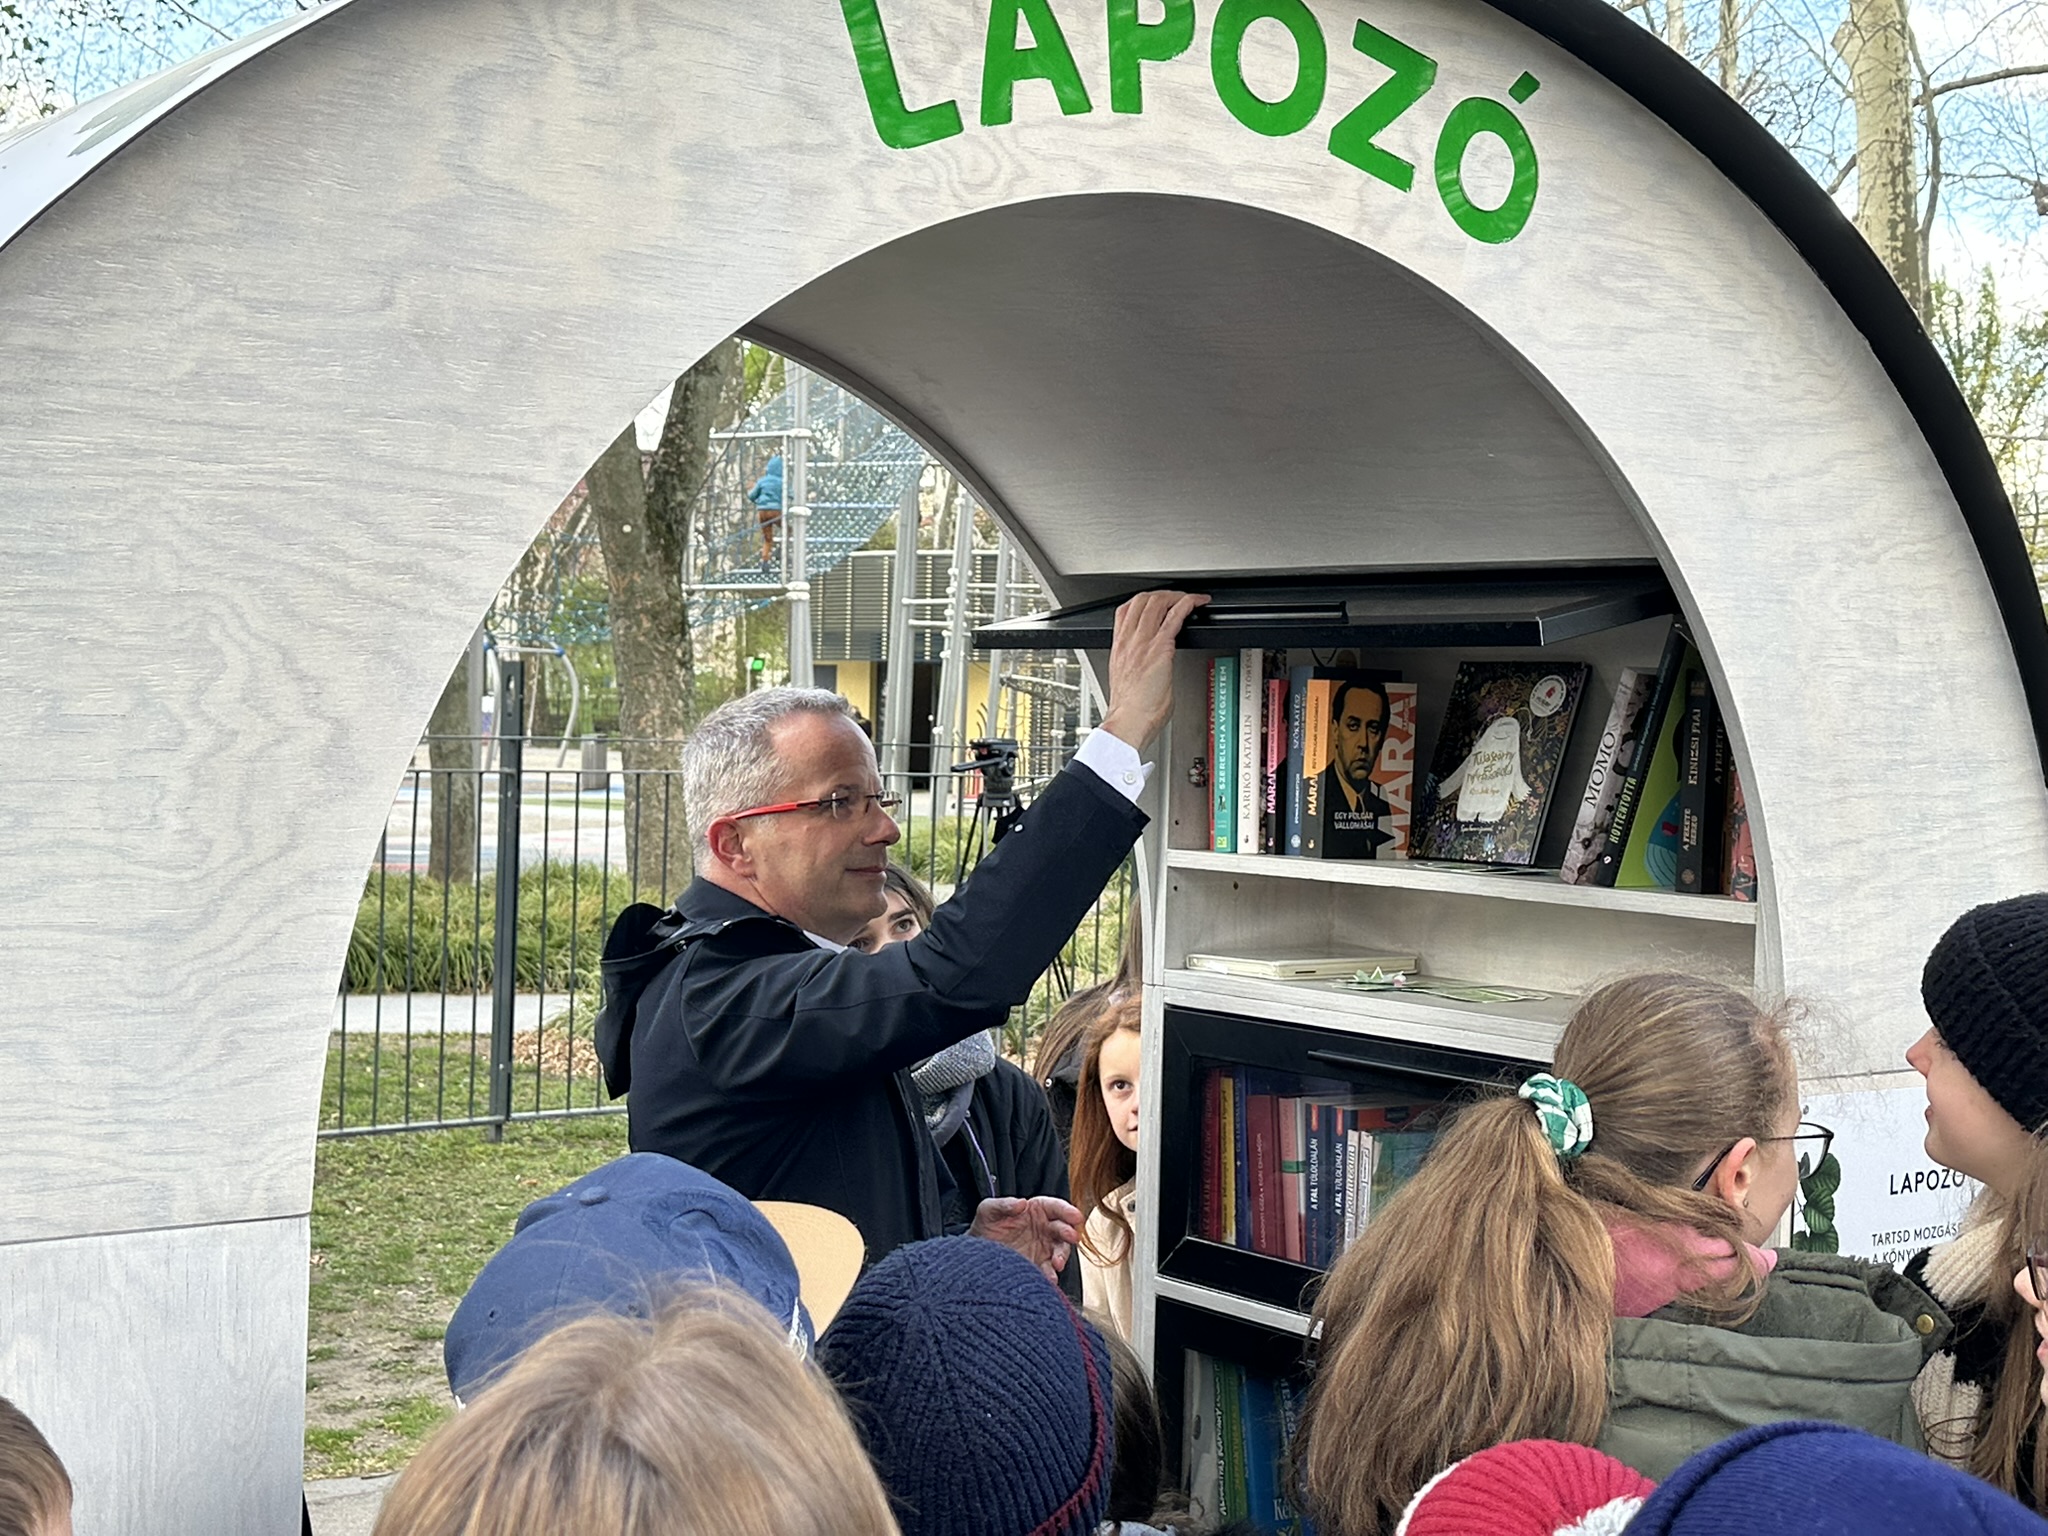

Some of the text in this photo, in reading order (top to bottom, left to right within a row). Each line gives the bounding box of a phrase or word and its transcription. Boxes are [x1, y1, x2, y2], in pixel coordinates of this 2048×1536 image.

[840, 0, 1541, 244] LAPOZÓ
[1218, 666, 1226, 790] SZERELEM A VÉGZETEM
[1243, 714, 1252, 769] KATALIN
[1688, 737, 1700, 785] KINIZSI
[1242, 772, 1251, 820] KARIKÓ
[1368, 683, 1418, 859] MÁRAI
[1585, 730, 1616, 809] MOMO
[1609, 776, 1638, 845] HOTTENTOTTA
[1872, 1229, 1911, 1247] TARTSD
